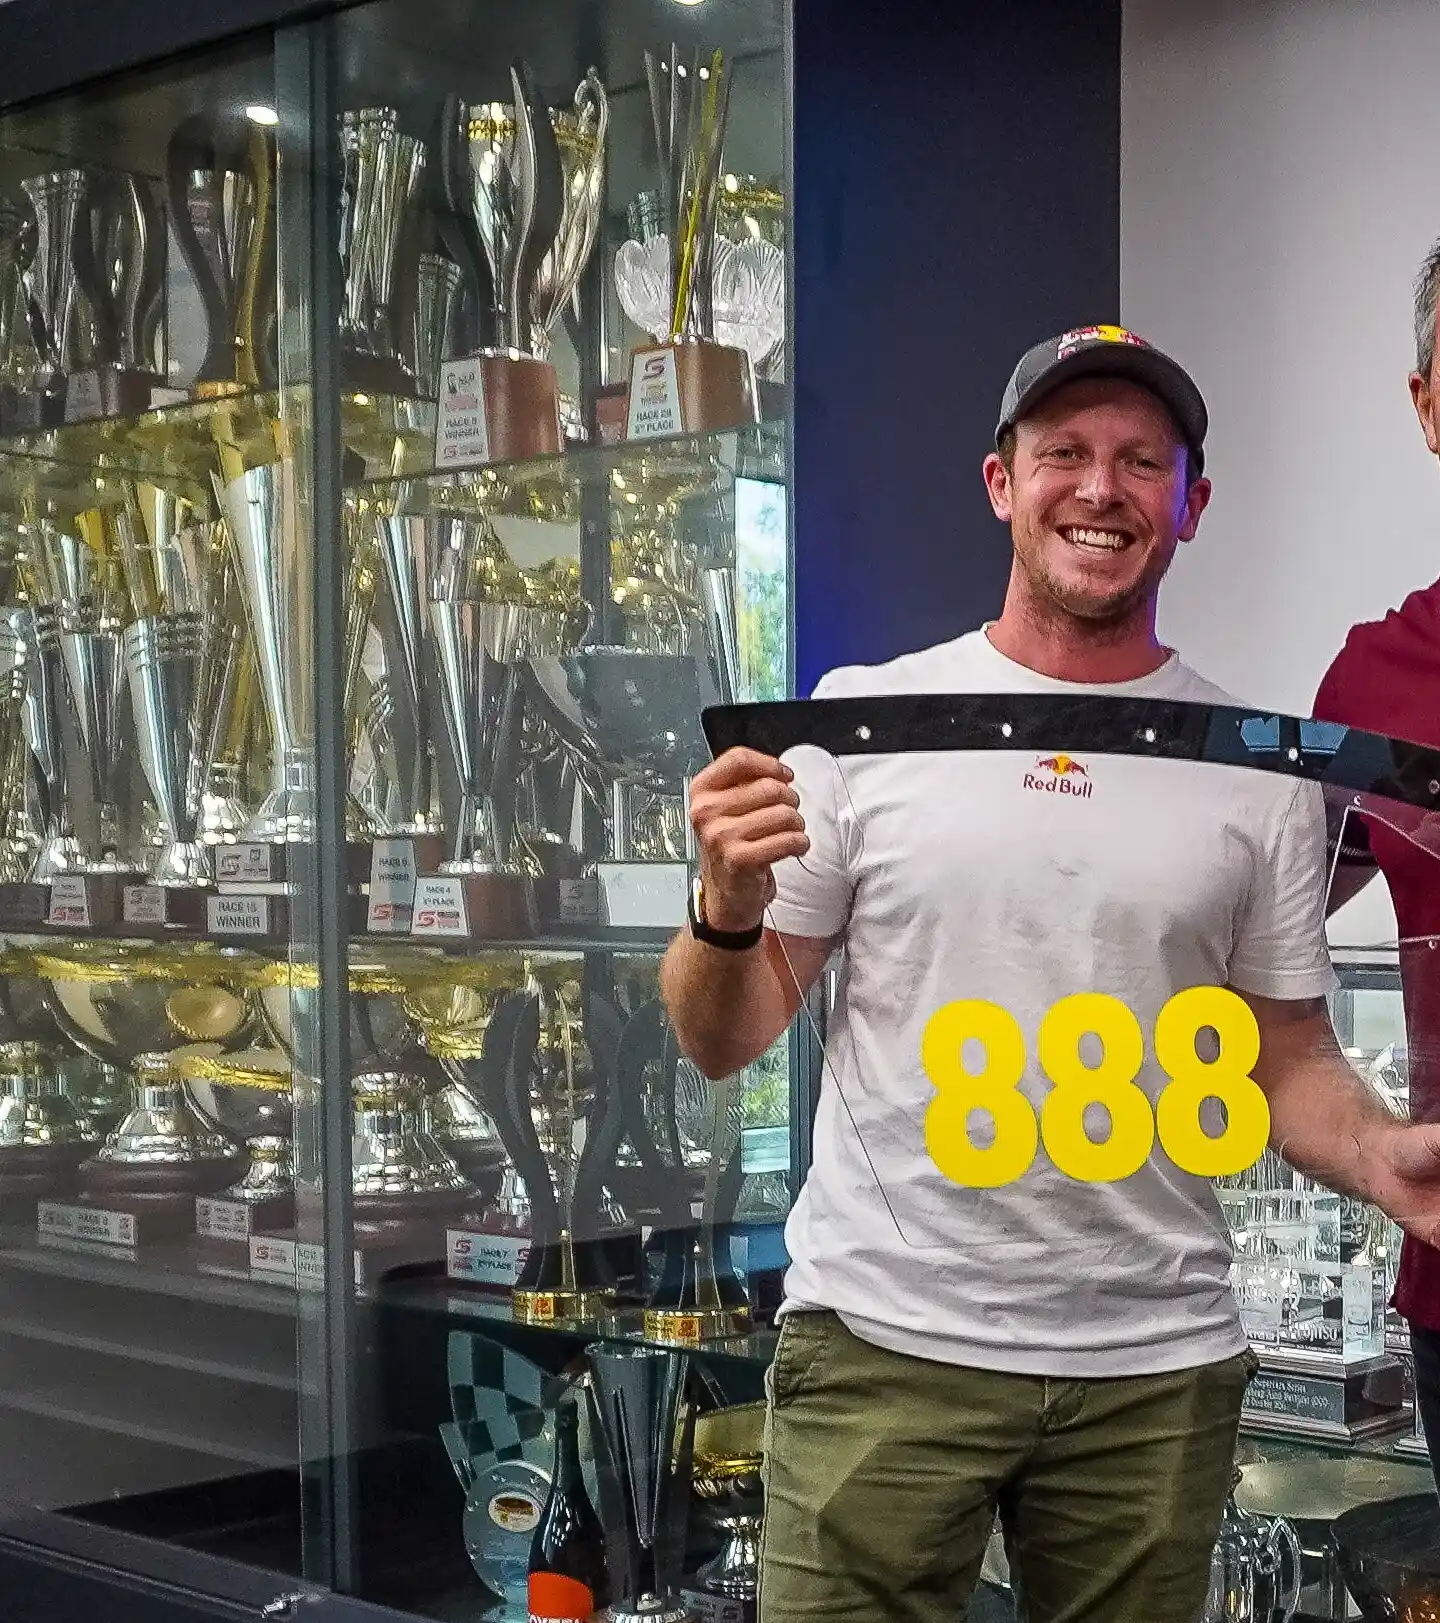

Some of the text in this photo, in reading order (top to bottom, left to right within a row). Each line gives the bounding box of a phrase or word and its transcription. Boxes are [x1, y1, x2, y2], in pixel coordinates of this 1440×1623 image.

[1023, 773, 1093, 799] Red Bull
[216, 915, 261, 929] WINNER
[921, 984, 1271, 1190] 888
